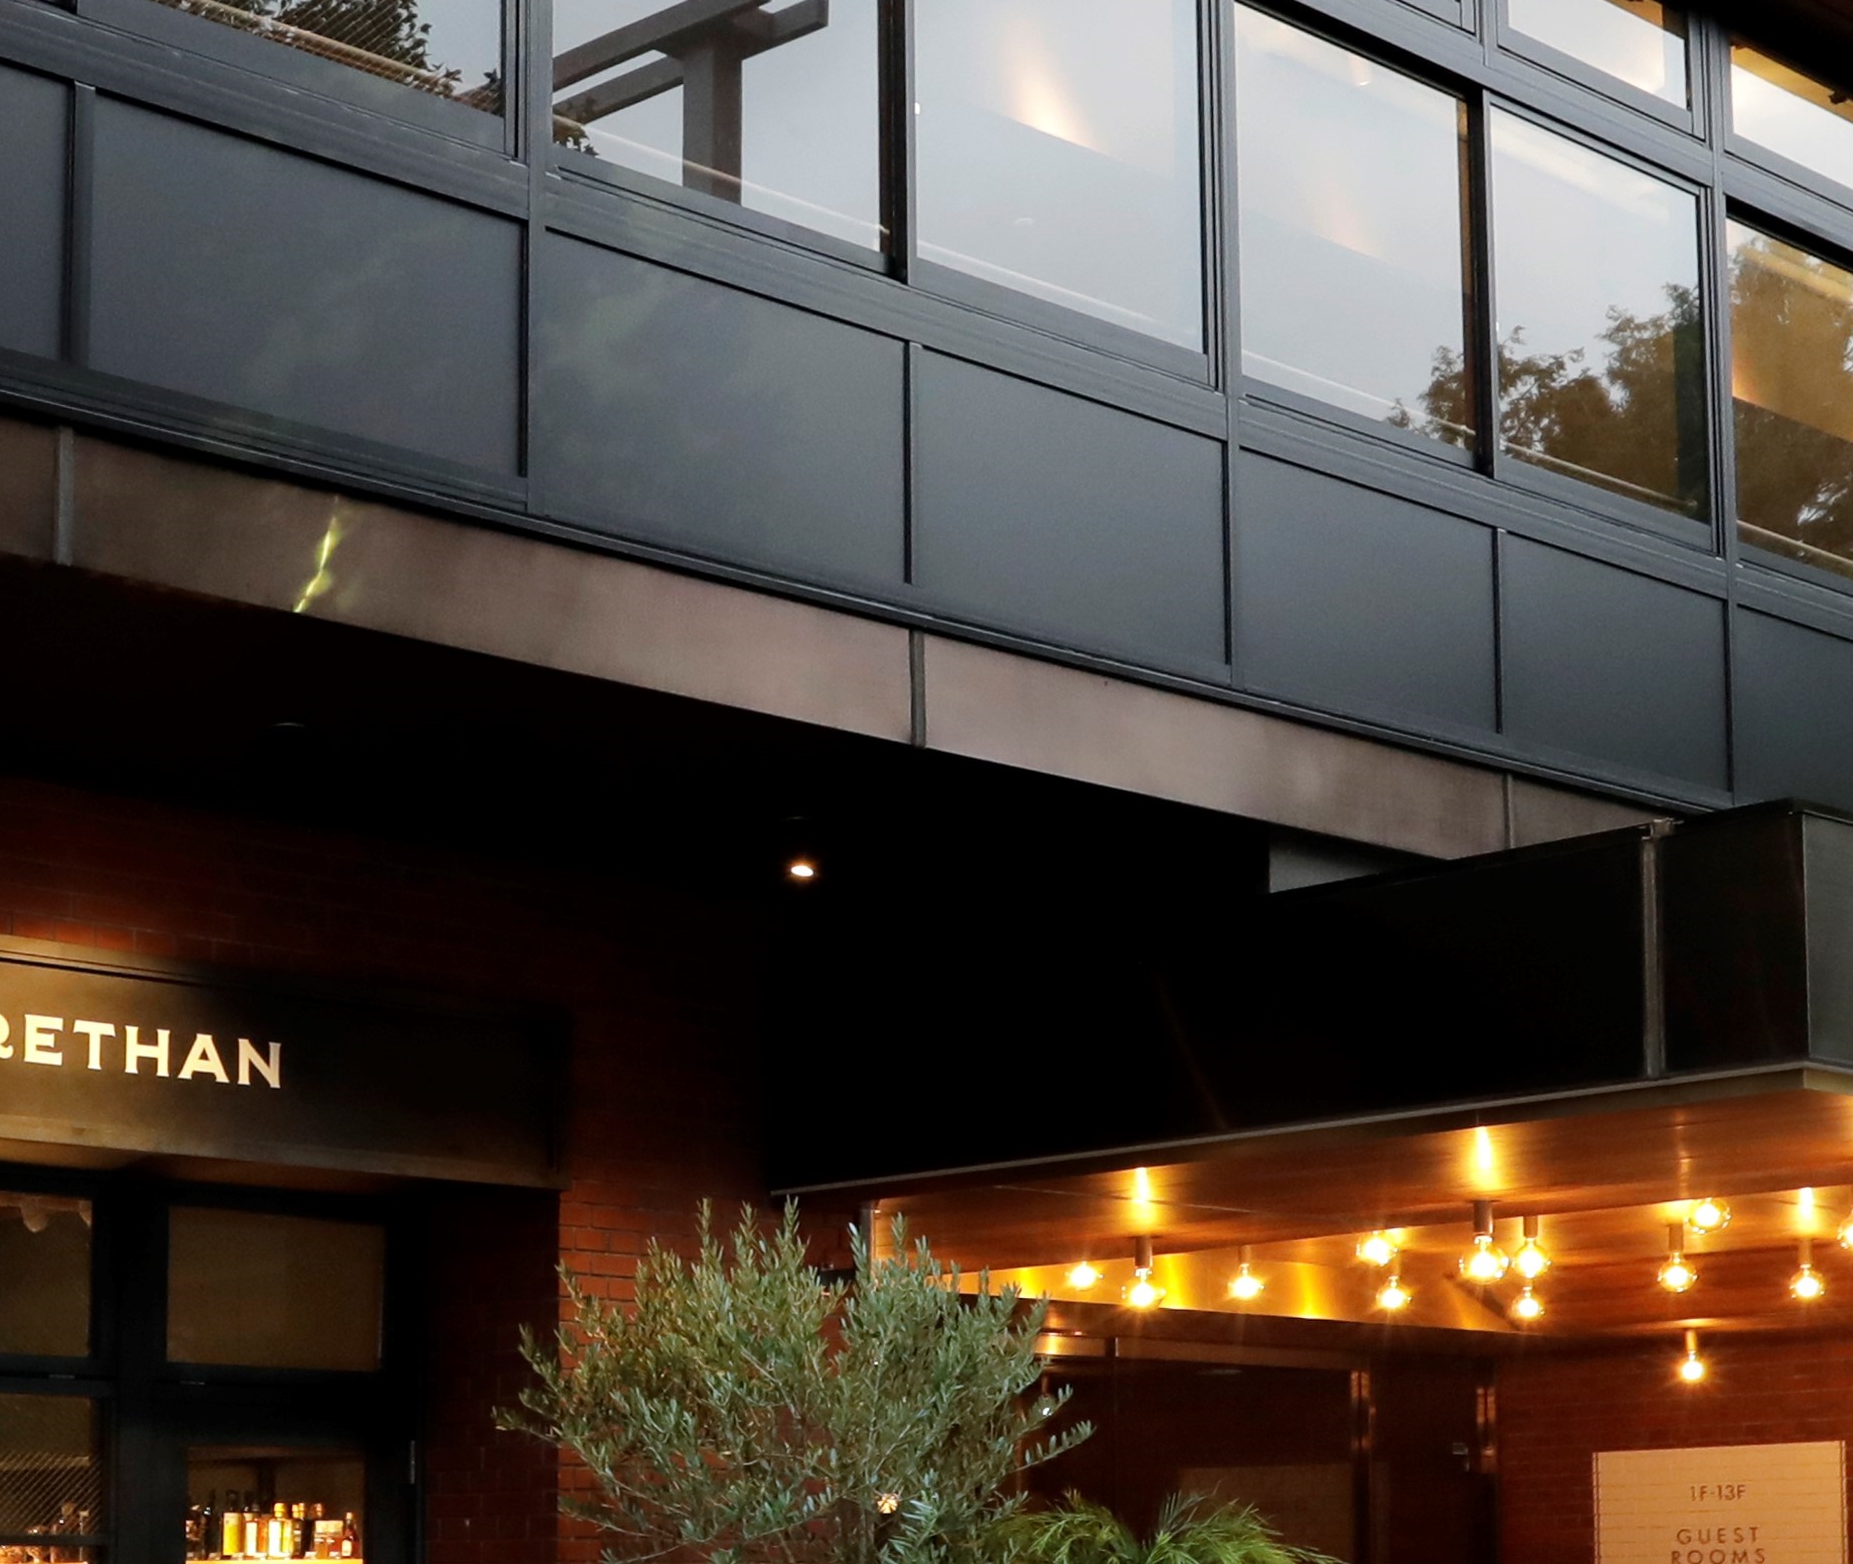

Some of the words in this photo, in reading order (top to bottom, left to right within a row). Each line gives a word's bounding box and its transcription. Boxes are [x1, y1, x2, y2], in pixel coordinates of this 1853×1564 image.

[1689, 1483, 1746, 1502] 1F-13F
[1675, 1525, 1760, 1545] GUEST
[1670, 1547, 1766, 1564] ROOMS
